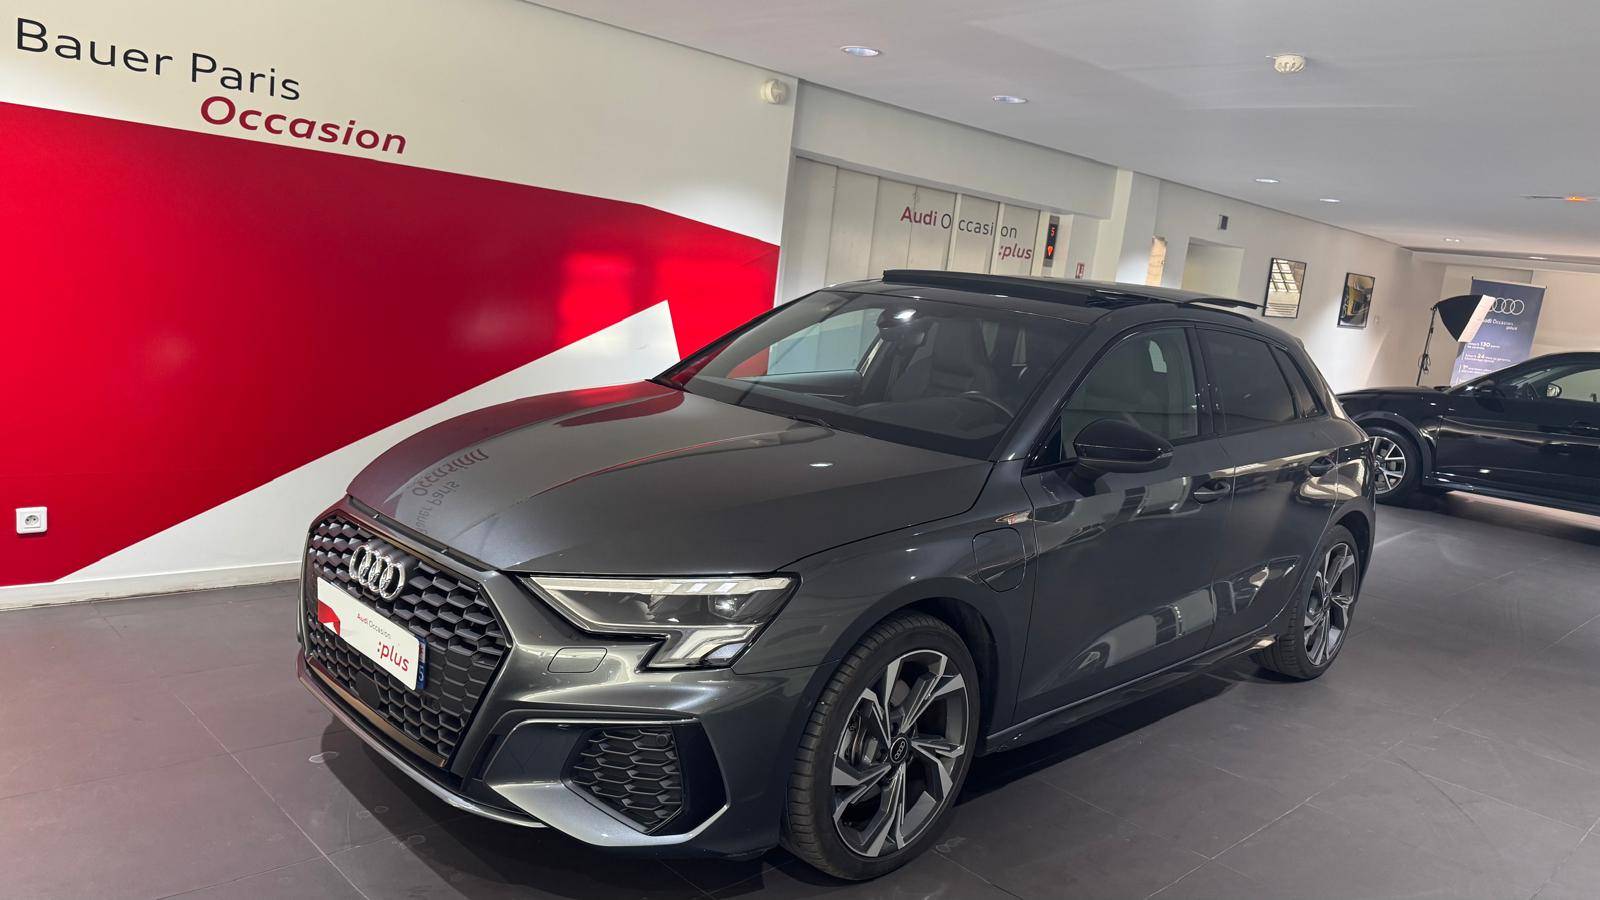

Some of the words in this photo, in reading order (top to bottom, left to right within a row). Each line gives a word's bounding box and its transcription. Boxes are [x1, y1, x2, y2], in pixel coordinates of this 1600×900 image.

[16, 17, 173, 76] Bauer
[190, 52, 301, 101] Paris
[200, 96, 407, 154] Occasion
[900, 206, 937, 226] Audi
[377, 641, 410, 672] :plus
